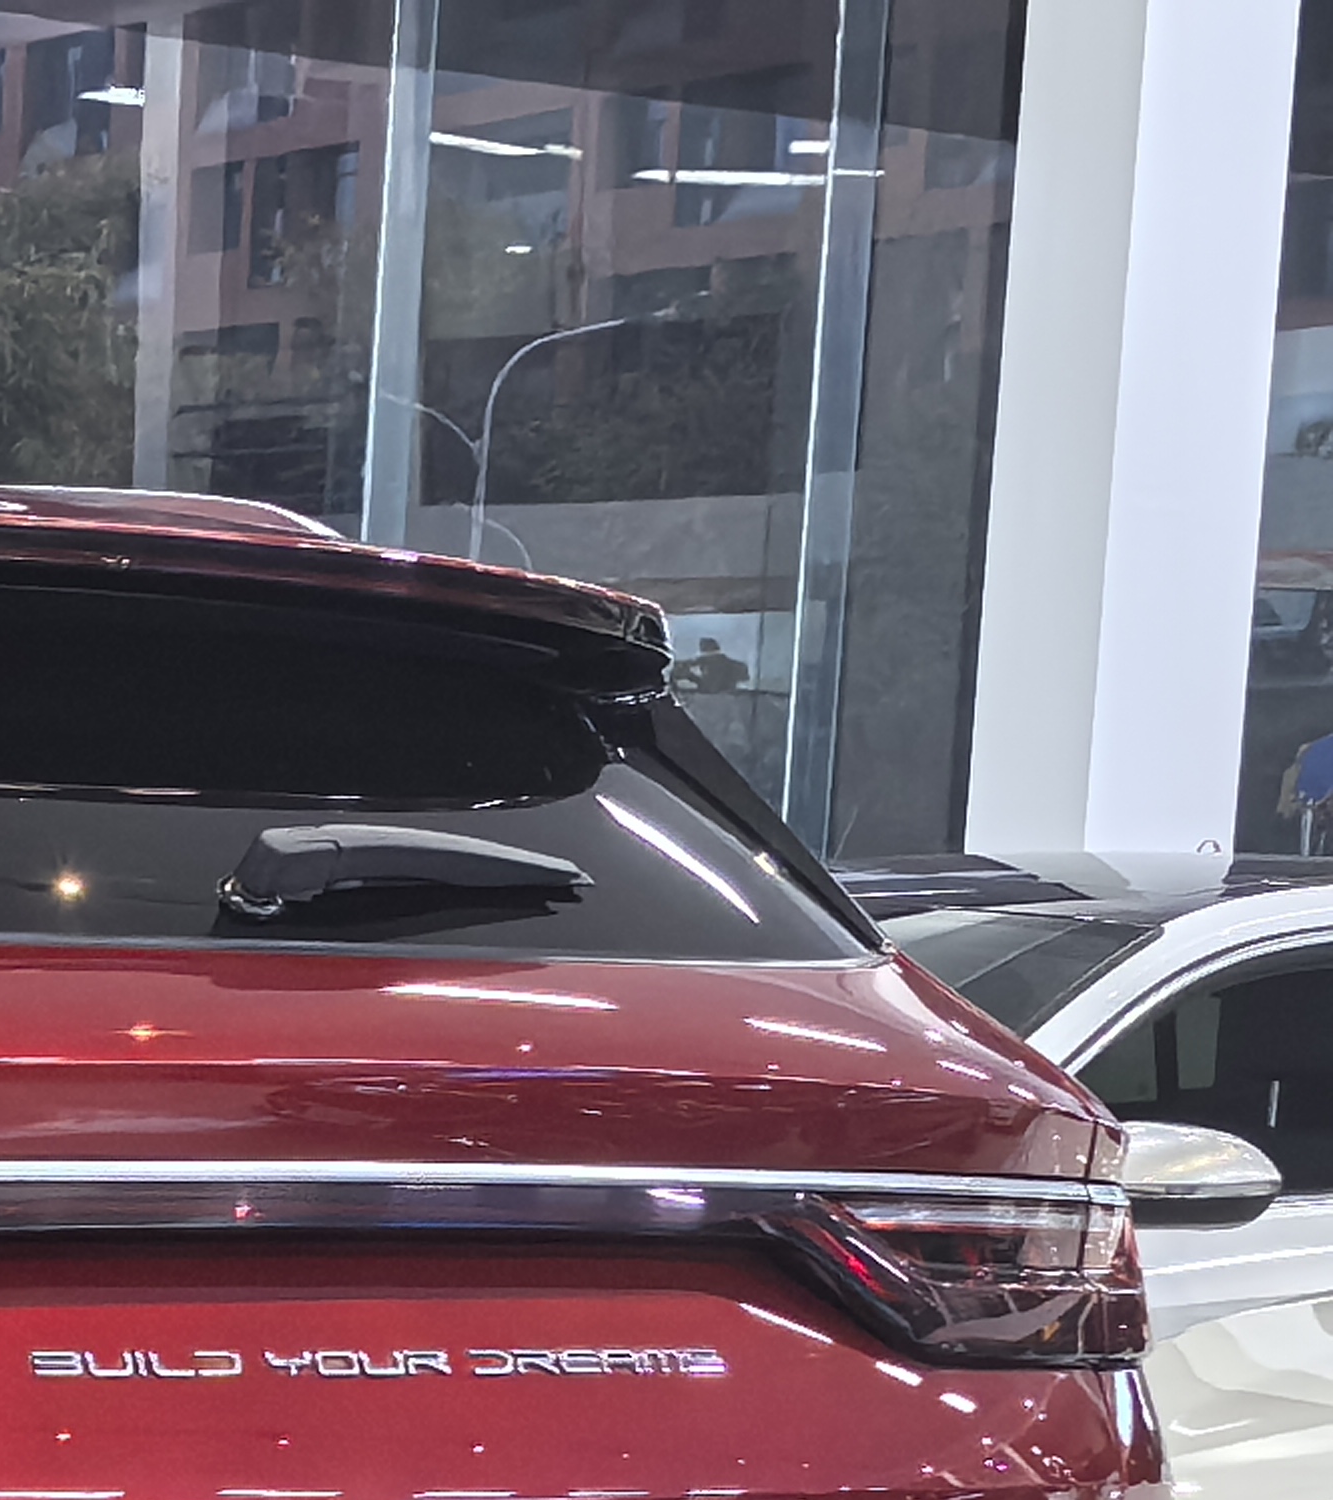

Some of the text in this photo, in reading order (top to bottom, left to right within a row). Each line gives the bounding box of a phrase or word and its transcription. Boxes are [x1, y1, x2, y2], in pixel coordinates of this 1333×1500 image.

[30, 1348, 726, 1377] BUILD YOUR DREAMS
